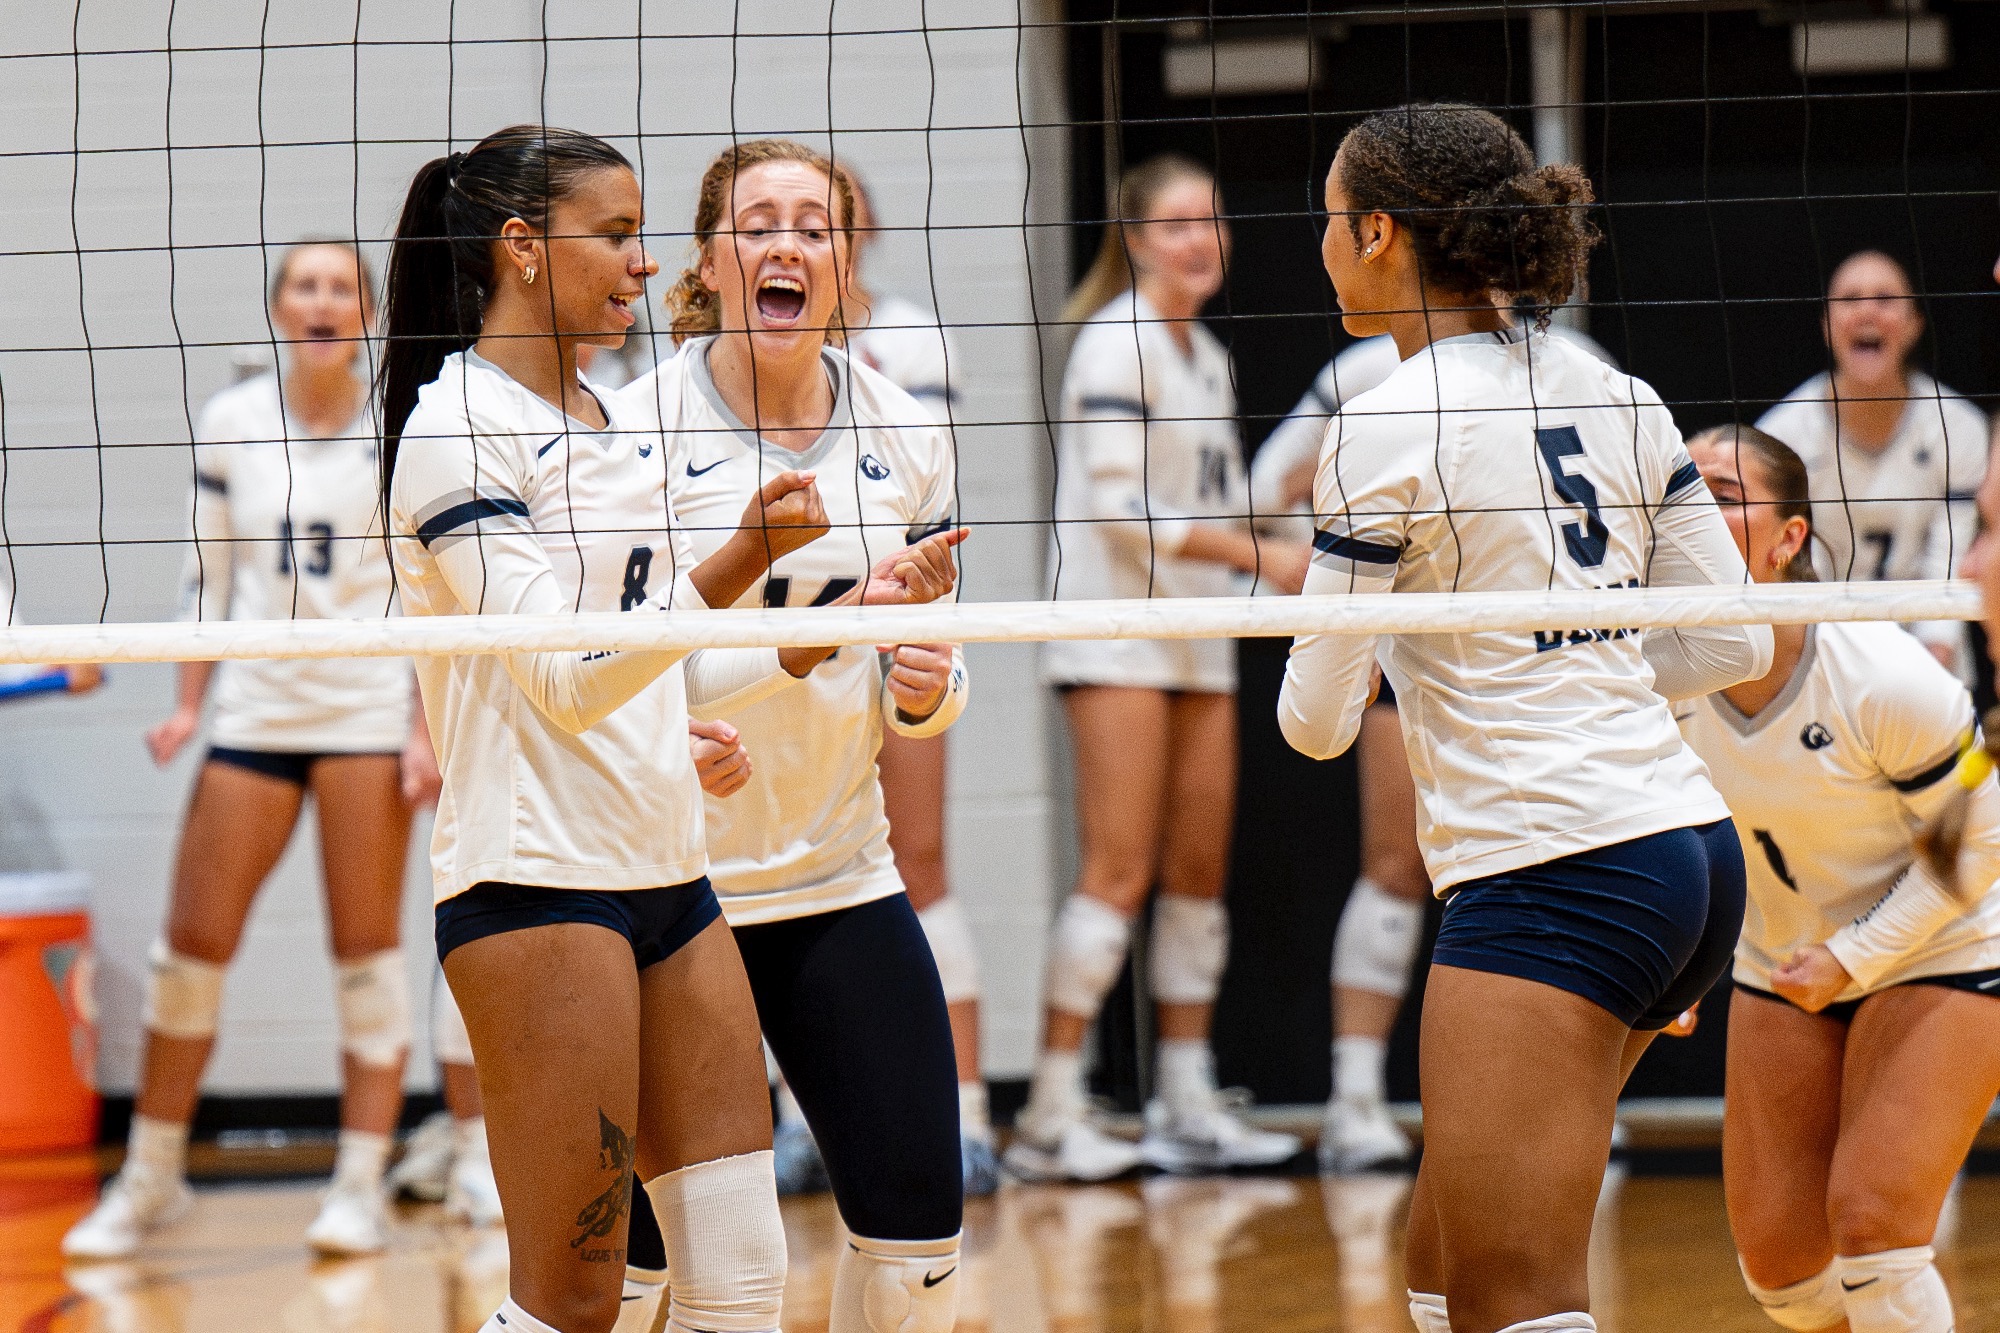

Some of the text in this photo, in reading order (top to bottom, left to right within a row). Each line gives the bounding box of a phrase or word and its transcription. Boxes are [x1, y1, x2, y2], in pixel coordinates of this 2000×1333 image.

[1532, 422, 1610, 571] 5
[278, 518, 333, 578] 13
[620, 543, 654, 612] 8
[1861, 528, 1895, 581] 7
[1752, 828, 1799, 892] 1
